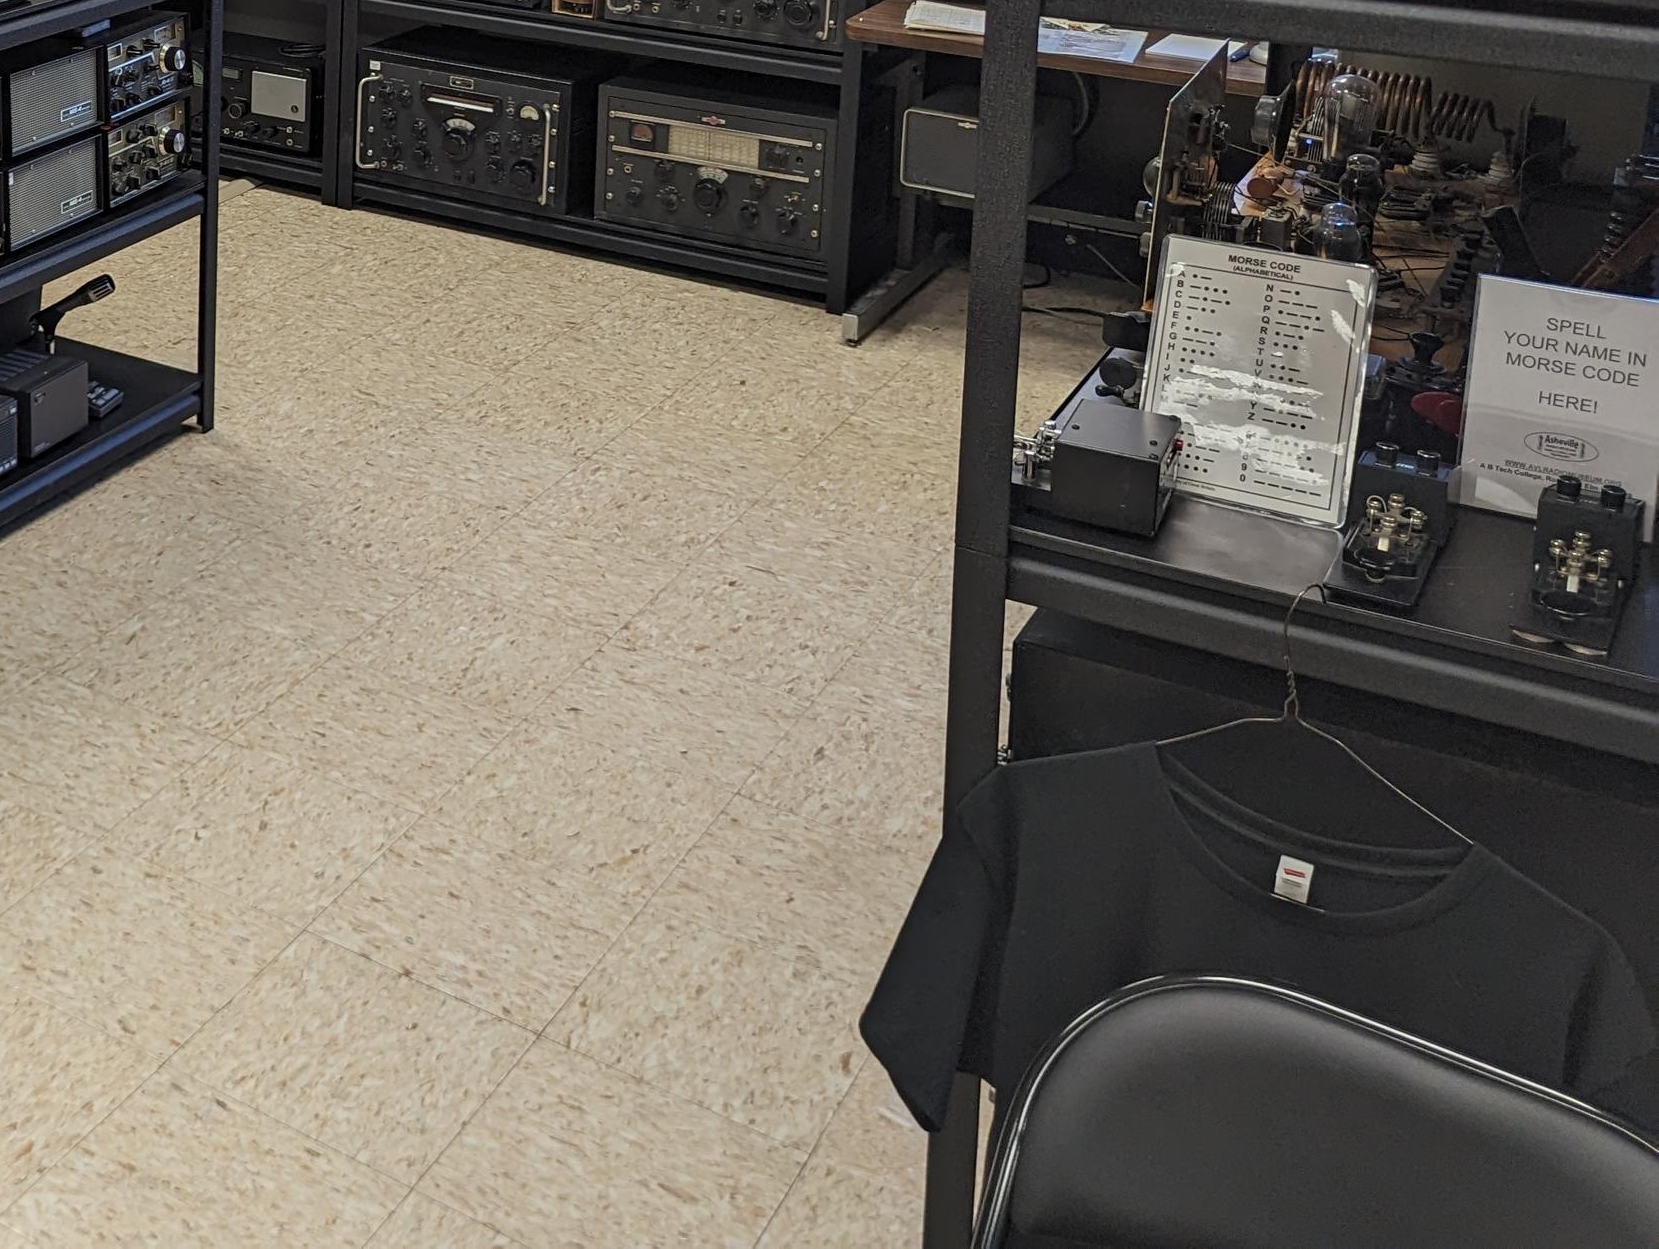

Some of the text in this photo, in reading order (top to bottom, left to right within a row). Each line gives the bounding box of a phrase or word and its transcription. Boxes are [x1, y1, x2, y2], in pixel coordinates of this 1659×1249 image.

[1228, 254, 1301, 274] MORSE CODE
[1232, 265, 1294, 281] (ALPHABETICAL)
[1176, 279, 1185, 288] B
[1265, 284, 1274, 292] N
[1175, 290, 1183, 299] C
[1264, 294, 1273, 303] O
[1173, 300, 1182, 309] D
[1262, 304, 1271, 313] P
[1172, 311, 1180, 319] E
[1261, 315, 1270, 325] Q
[1171, 321, 1177, 329] F
[1546, 317, 1607, 340] SPELL
[1259, 326, 1268, 335] R
[1169, 332, 1178, 341] G
[1258, 337, 1266, 346] S
[1167, 342, 1176, 351] H
[1504, 330, 1647, 367] YOUR NAME IN
[1256, 347, 1264, 356] T
[1255, 358, 1264, 367] U
[1505, 352, 1640, 387] MORSE CODE
[1249, 401, 1258, 410] Y
[1538, 390, 1599, 414] HERE!
[1247, 412, 1255, 421] Z
[1545, 434, 1579, 450] Asheville
[1241, 463, 1248, 472] 9
[1495, 465, 1513, 475] Tech
